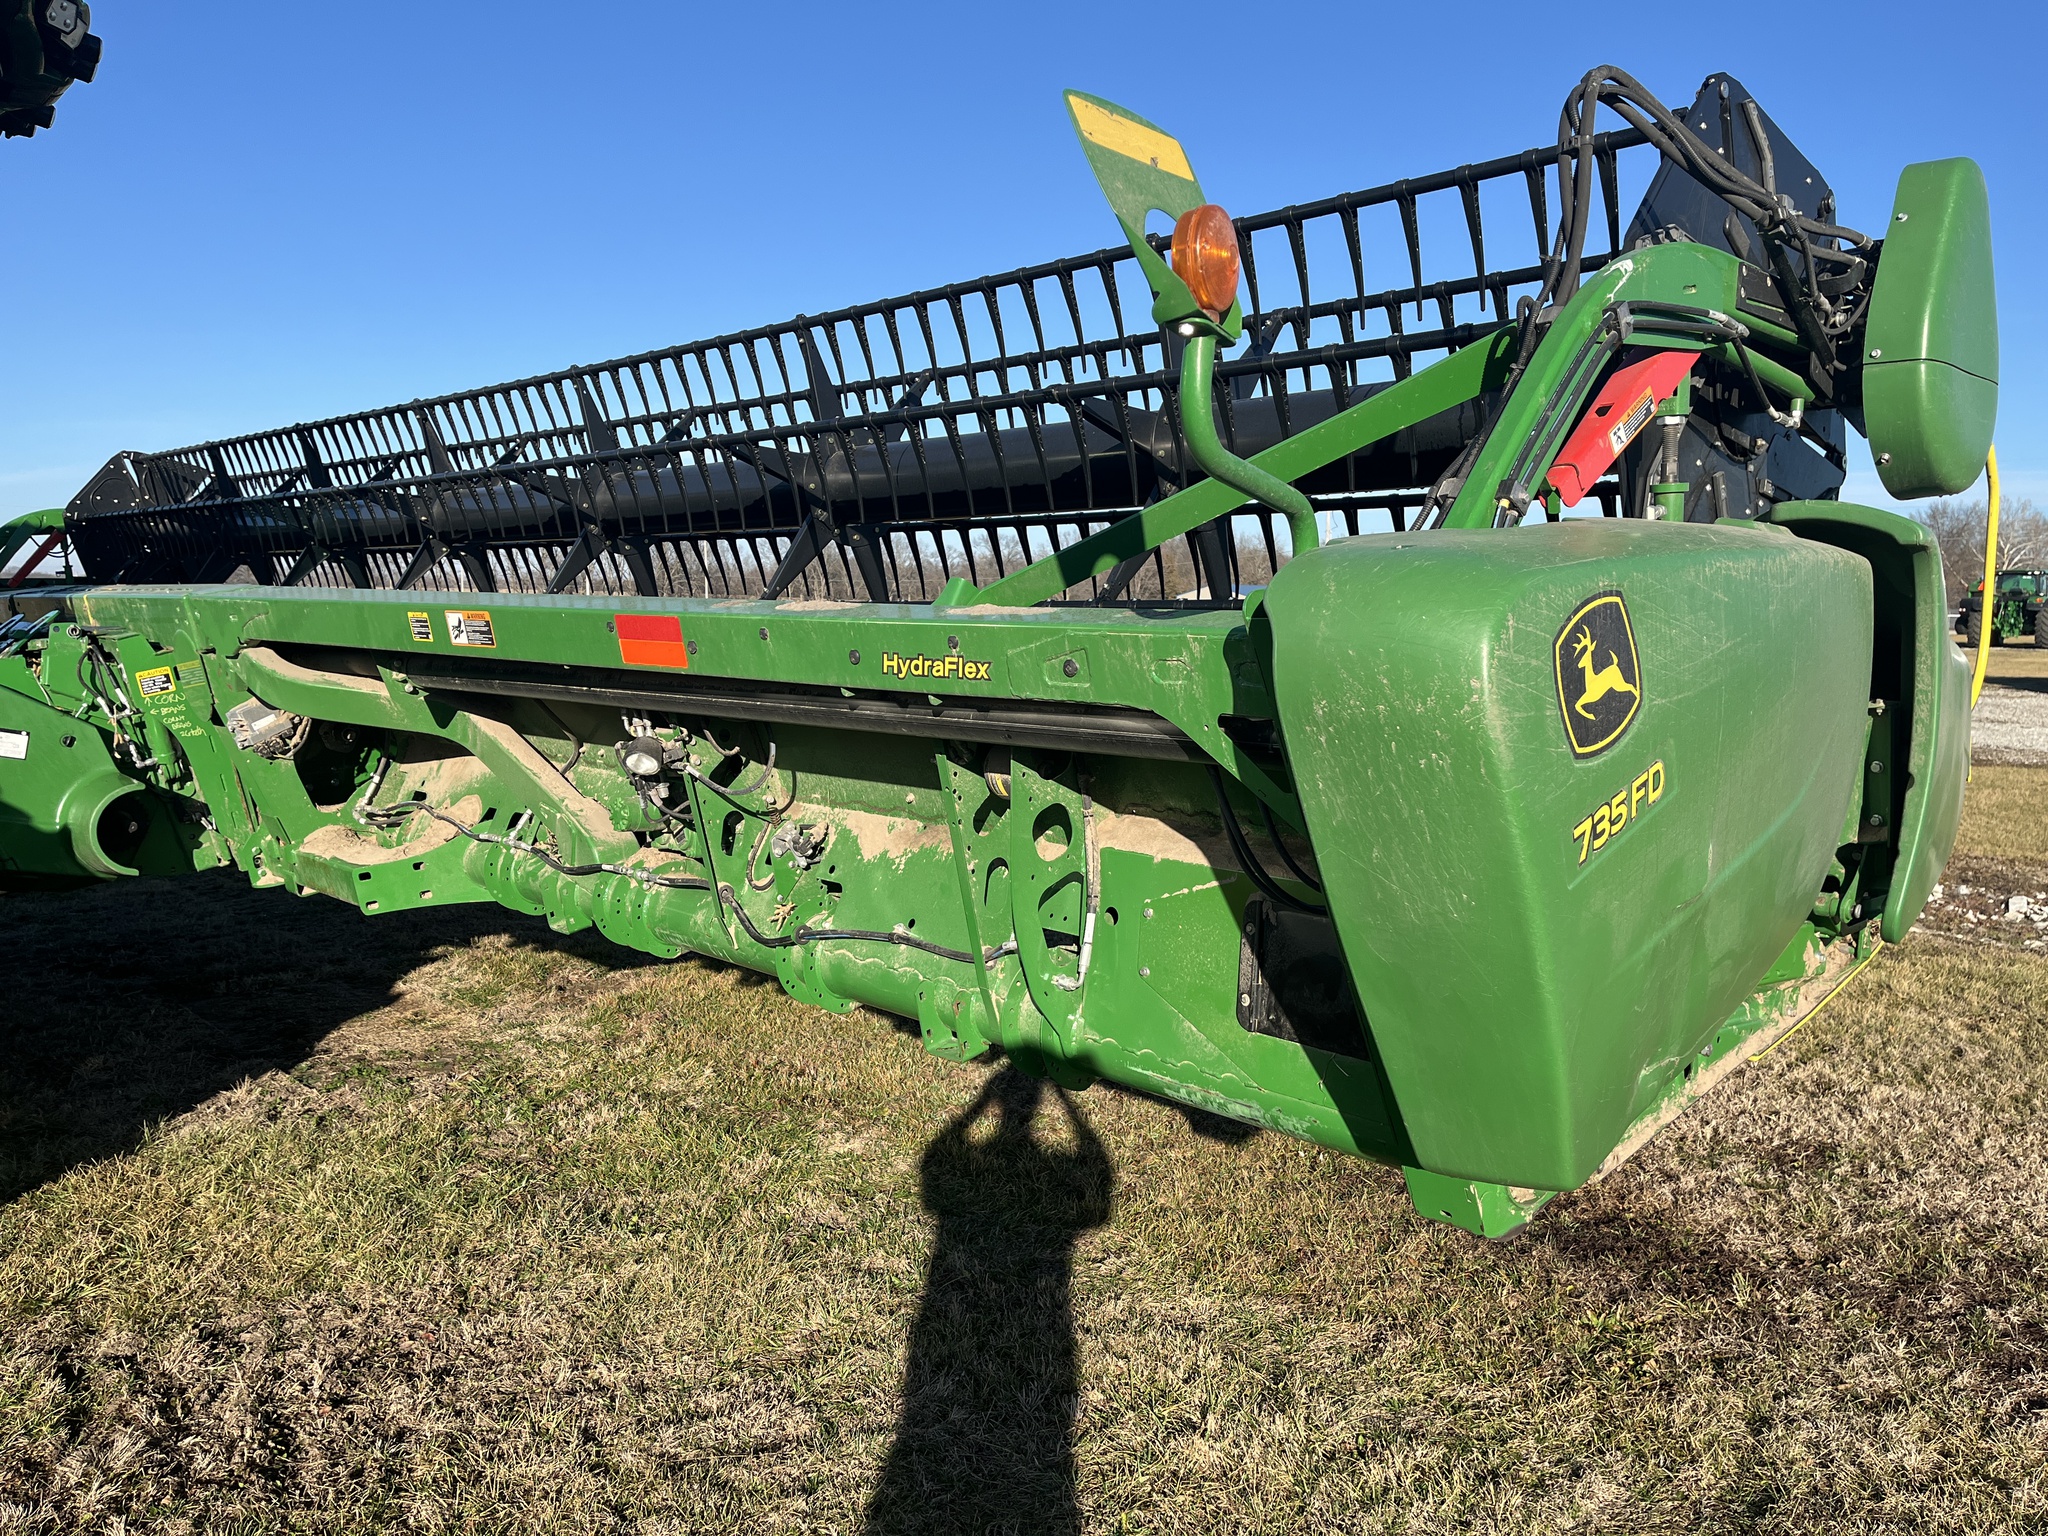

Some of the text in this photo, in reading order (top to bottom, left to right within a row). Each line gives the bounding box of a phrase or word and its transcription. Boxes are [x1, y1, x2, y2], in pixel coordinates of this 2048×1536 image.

[142, 668, 169, 677] CAUTION
[881, 652, 992, 681] HydraFlex
[154, 692, 186, 704] CORN
[160, 703, 187, 716] BEANS
